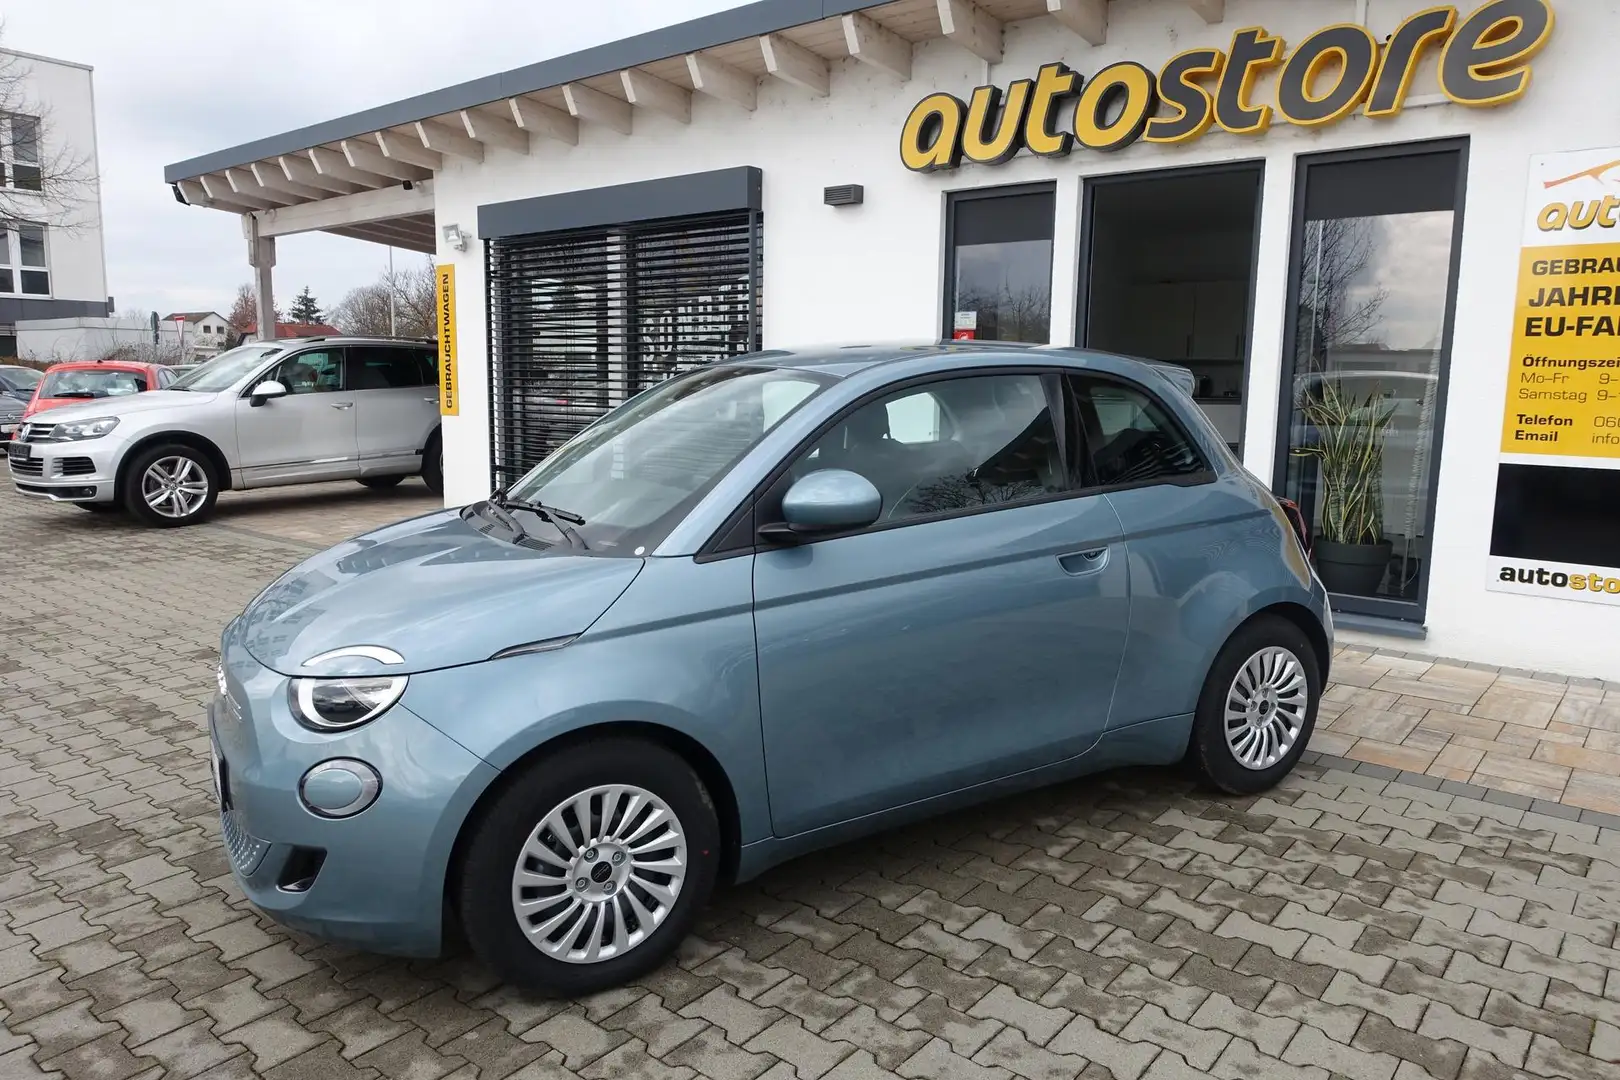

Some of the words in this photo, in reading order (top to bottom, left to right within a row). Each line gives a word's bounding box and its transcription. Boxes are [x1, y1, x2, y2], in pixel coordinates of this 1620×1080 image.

[900, 0, 1554, 172] autostore
[1536, 195, 1620, 232] aut
[1532, 257, 1620, 276] GEBRA
[1525, 316, 1620, 337] EU-FA
[442, 273, 453, 408] GEBRAUCHTWAGEN
[1518, 388, 1587, 403] Samstag
[1516, 414, 1573, 426] Telefon
[1594, 416, 1620, 428] 06
[1514, 430, 1558, 442] Email
[1499, 566, 1620, 594] autosto
